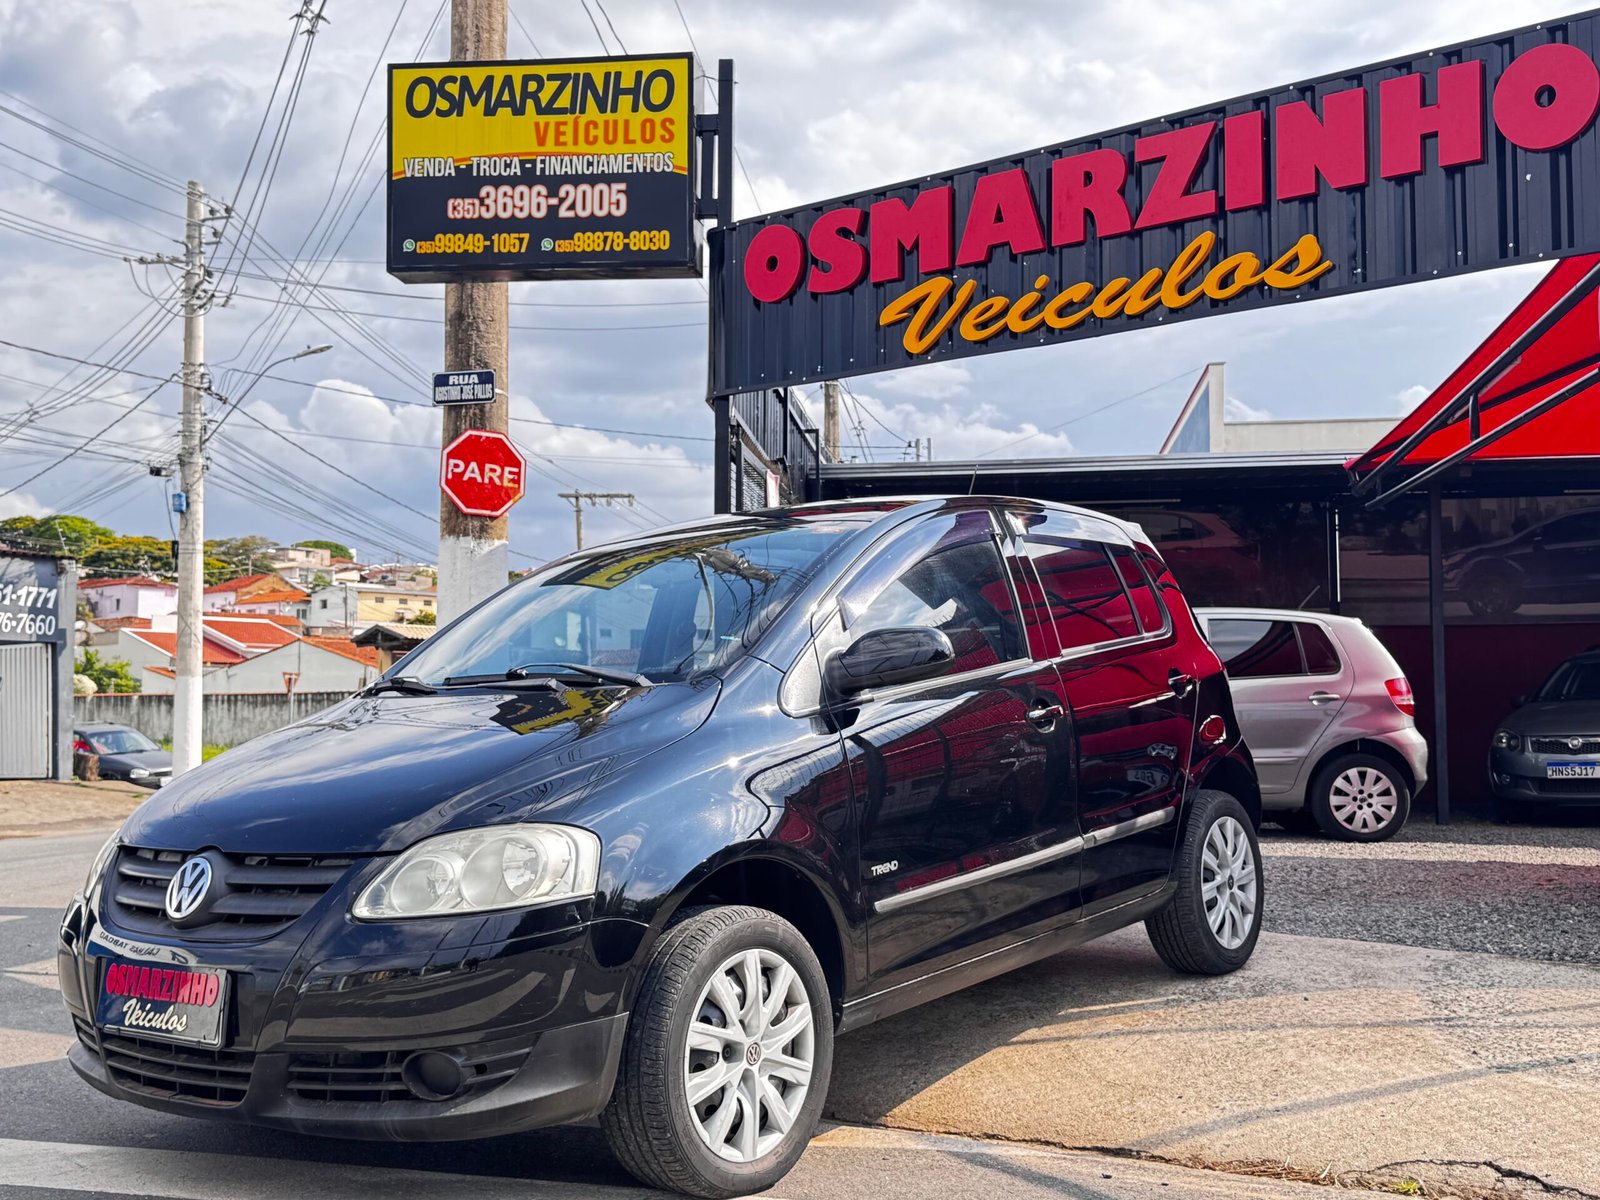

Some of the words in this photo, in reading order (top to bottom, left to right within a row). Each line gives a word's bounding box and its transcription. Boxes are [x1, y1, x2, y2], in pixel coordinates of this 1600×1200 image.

[405, 68, 675, 118] OSMARZINHO
[534, 116, 676, 147] VEÍCULOS
[403, 156, 456, 178] VENDA
[470, 155, 521, 177] TROCA
[535, 152, 674, 176] FINANCIAMENTOS
[743, 42, 1600, 304] OSMARZINHO
[447, 182, 628, 219] (35)3696-2005
[416, 233, 530, 254] (35)99849-1057
[555, 230, 670, 253] (35)98878-8030
[879, 230, 1335, 355] Veiculos
[448, 374, 479, 386] RUA
[447, 458, 520, 488] PARE
[1551, 766, 1596, 777] HNS5J17
[870, 860, 899, 876] TREND
[106, 963, 220, 1008] OSMARZINHO
